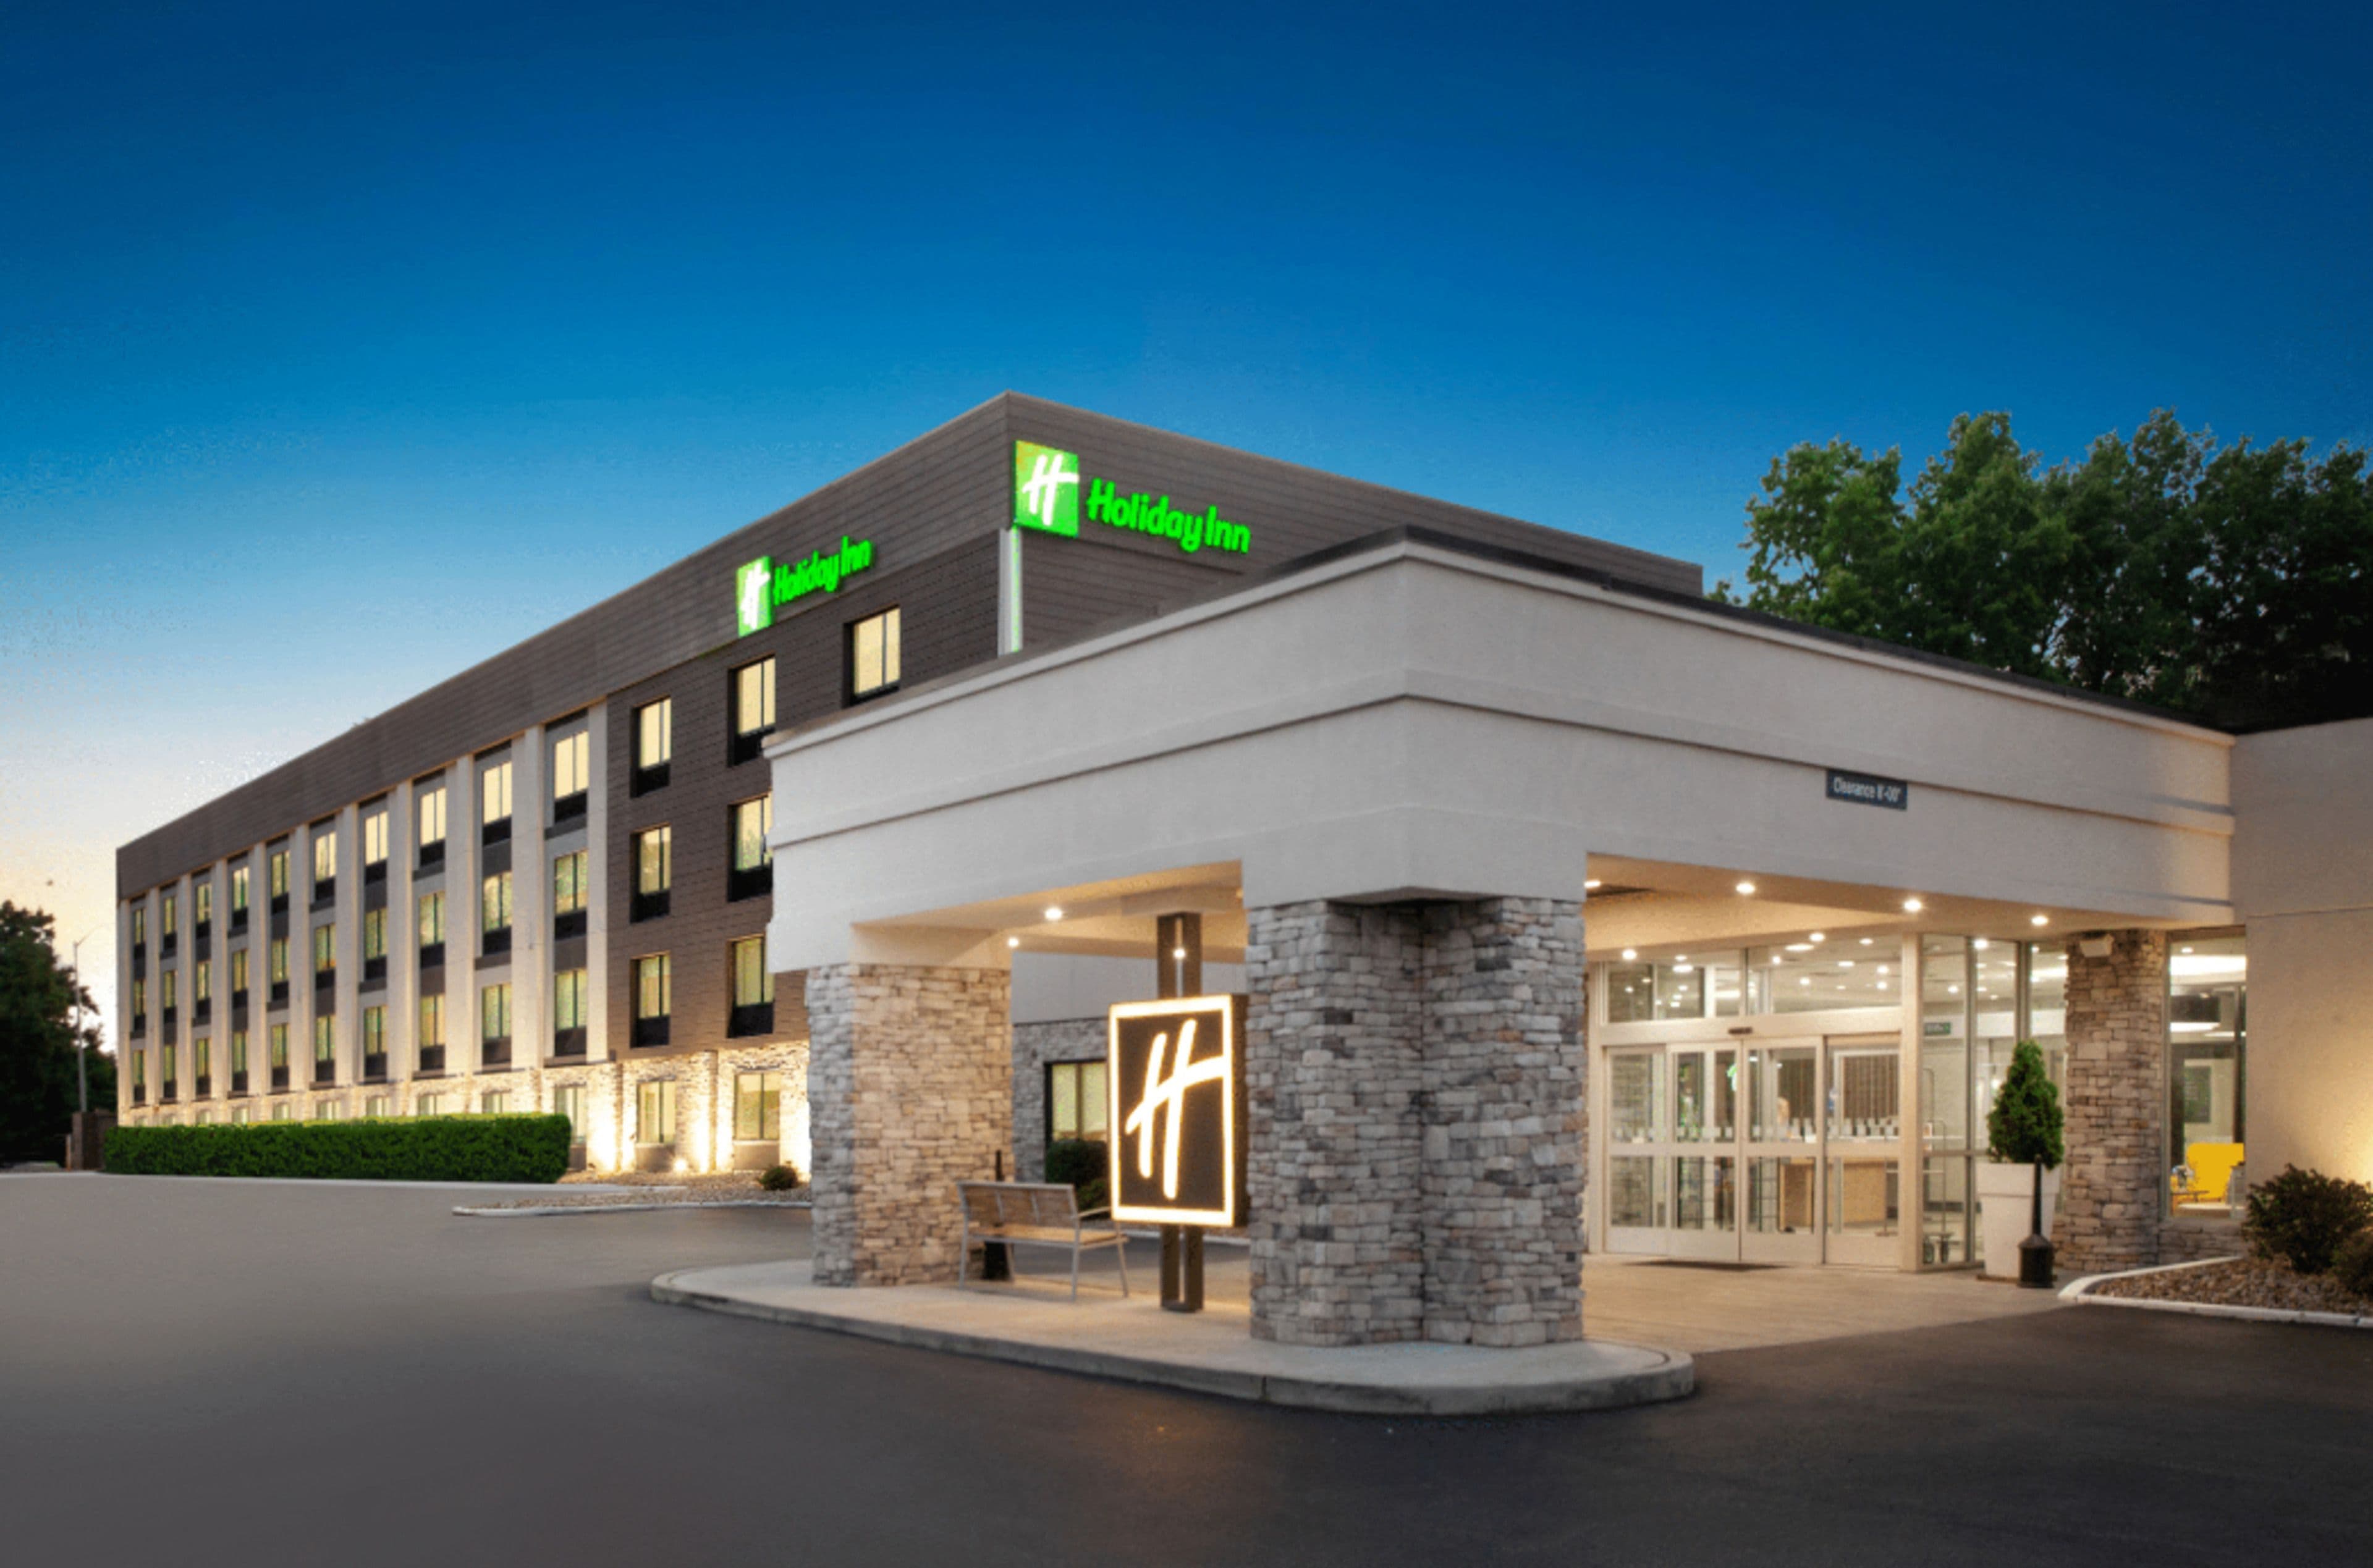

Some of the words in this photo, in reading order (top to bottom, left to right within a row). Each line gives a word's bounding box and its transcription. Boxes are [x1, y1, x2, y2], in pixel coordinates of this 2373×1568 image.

[1086, 478, 1203, 552] Holiday
[1204, 505, 1251, 554] Inn
[774, 550, 840, 606] Holiday
[840, 535, 873, 577] Inn
